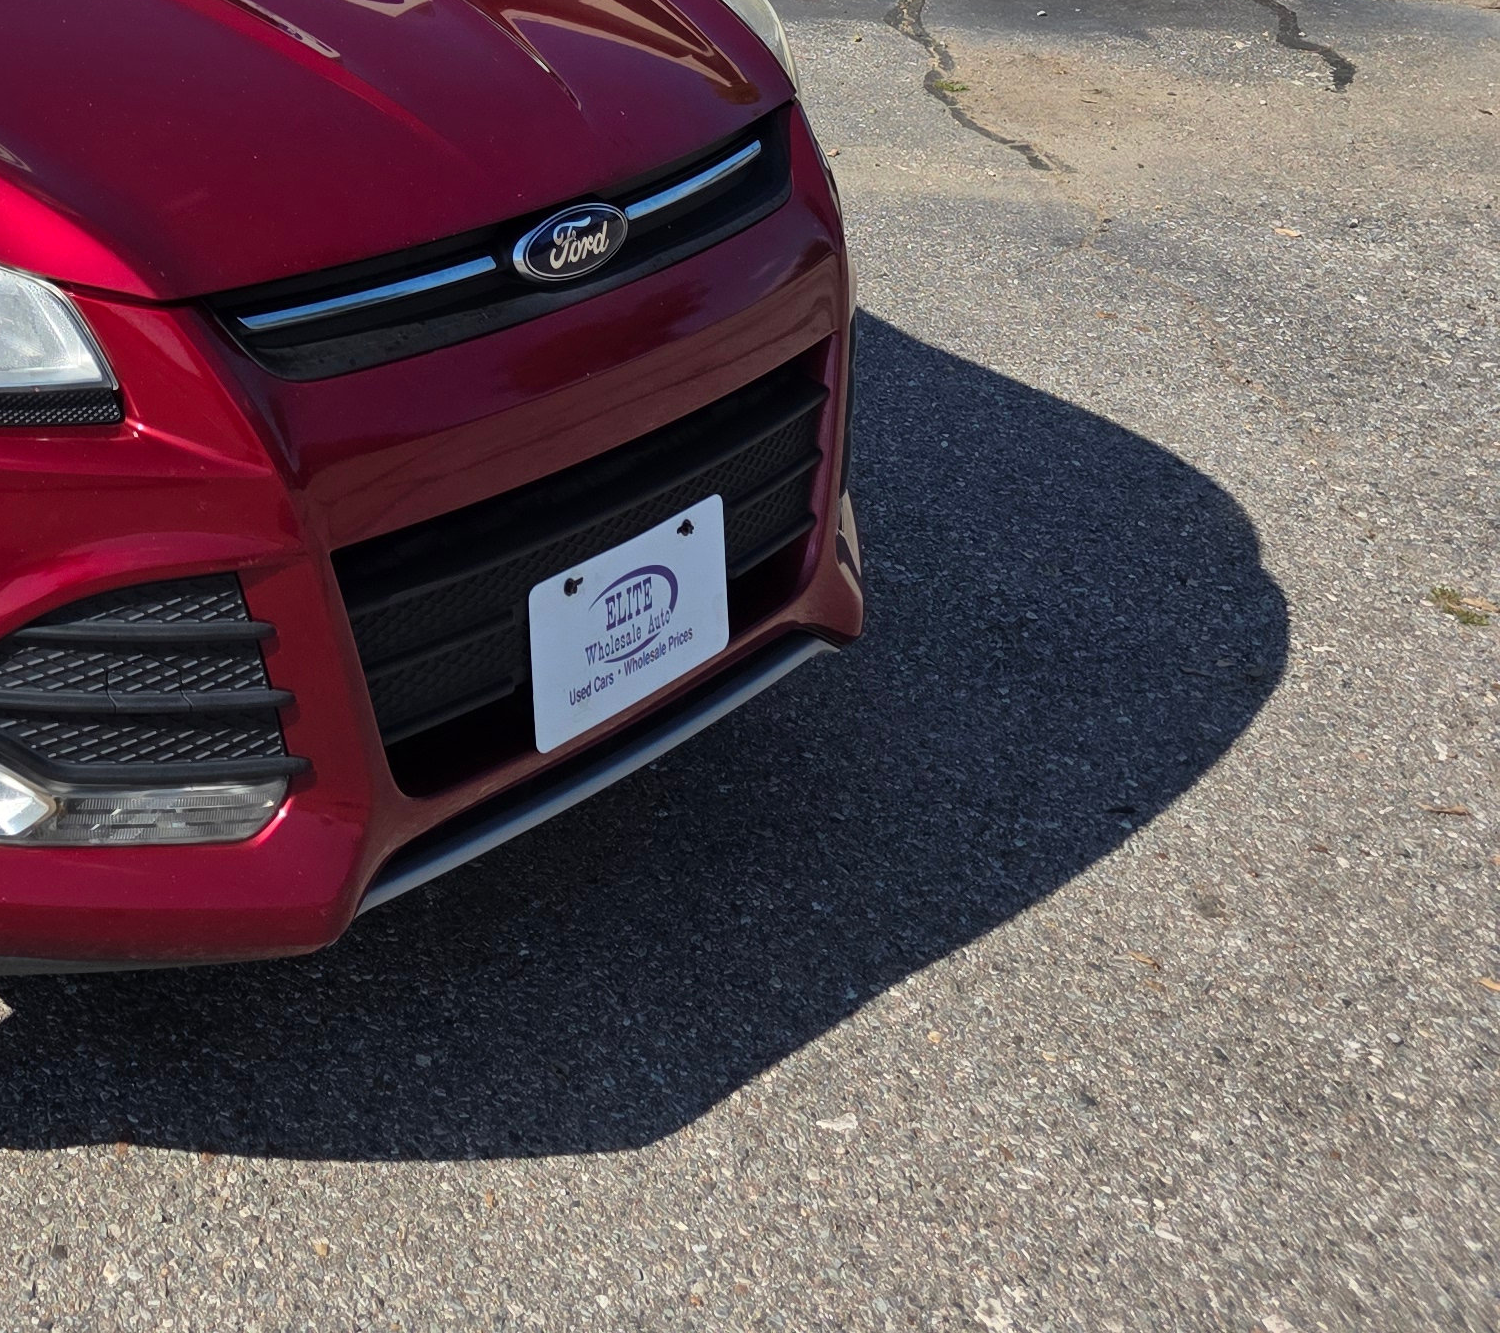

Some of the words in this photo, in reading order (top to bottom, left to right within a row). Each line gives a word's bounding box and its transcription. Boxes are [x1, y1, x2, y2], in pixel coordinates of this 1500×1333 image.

[549, 215, 609, 270] Ford
[605, 576, 653, 631] ELITE
[585, 625, 642, 666] Wholesale
[647, 608, 671, 636] Auto
[569, 683, 592, 706] Used
[594, 670, 615, 693] Cars
[623, 642, 667, 677] Wholesale
[668, 626, 693, 653] Prices
